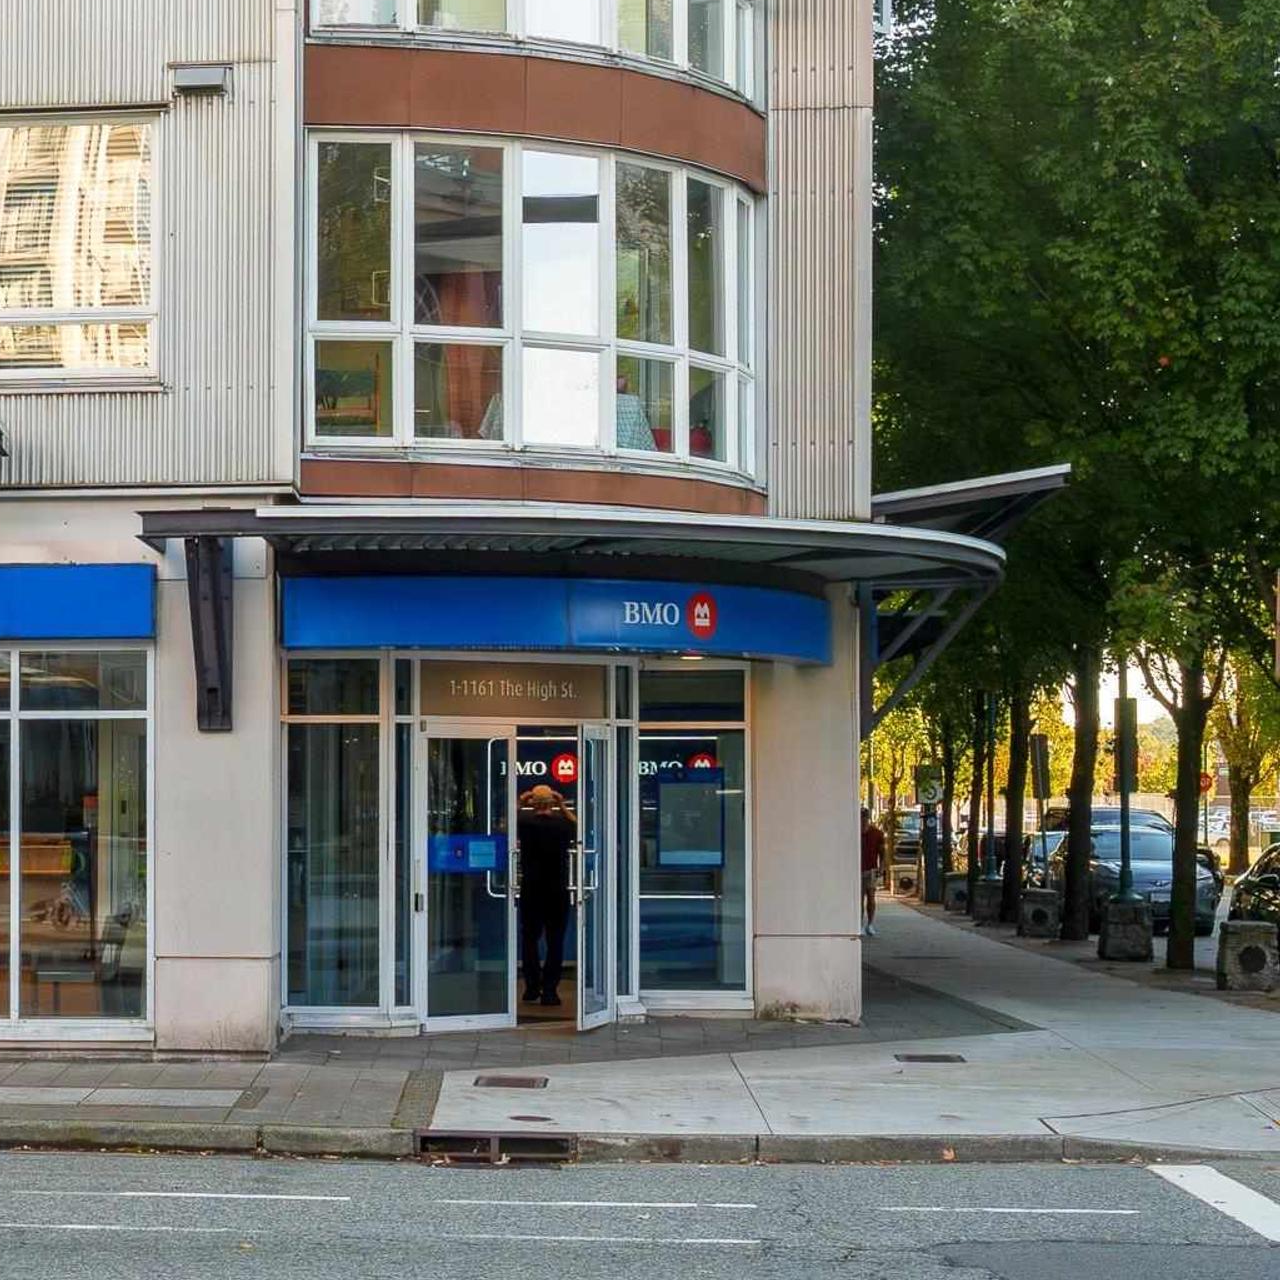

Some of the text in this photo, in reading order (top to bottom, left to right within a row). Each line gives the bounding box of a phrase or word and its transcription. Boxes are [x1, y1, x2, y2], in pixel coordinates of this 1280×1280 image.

[623, 601, 680, 625] BMO
[450, 680, 578, 702] 1-1161 The High St.
